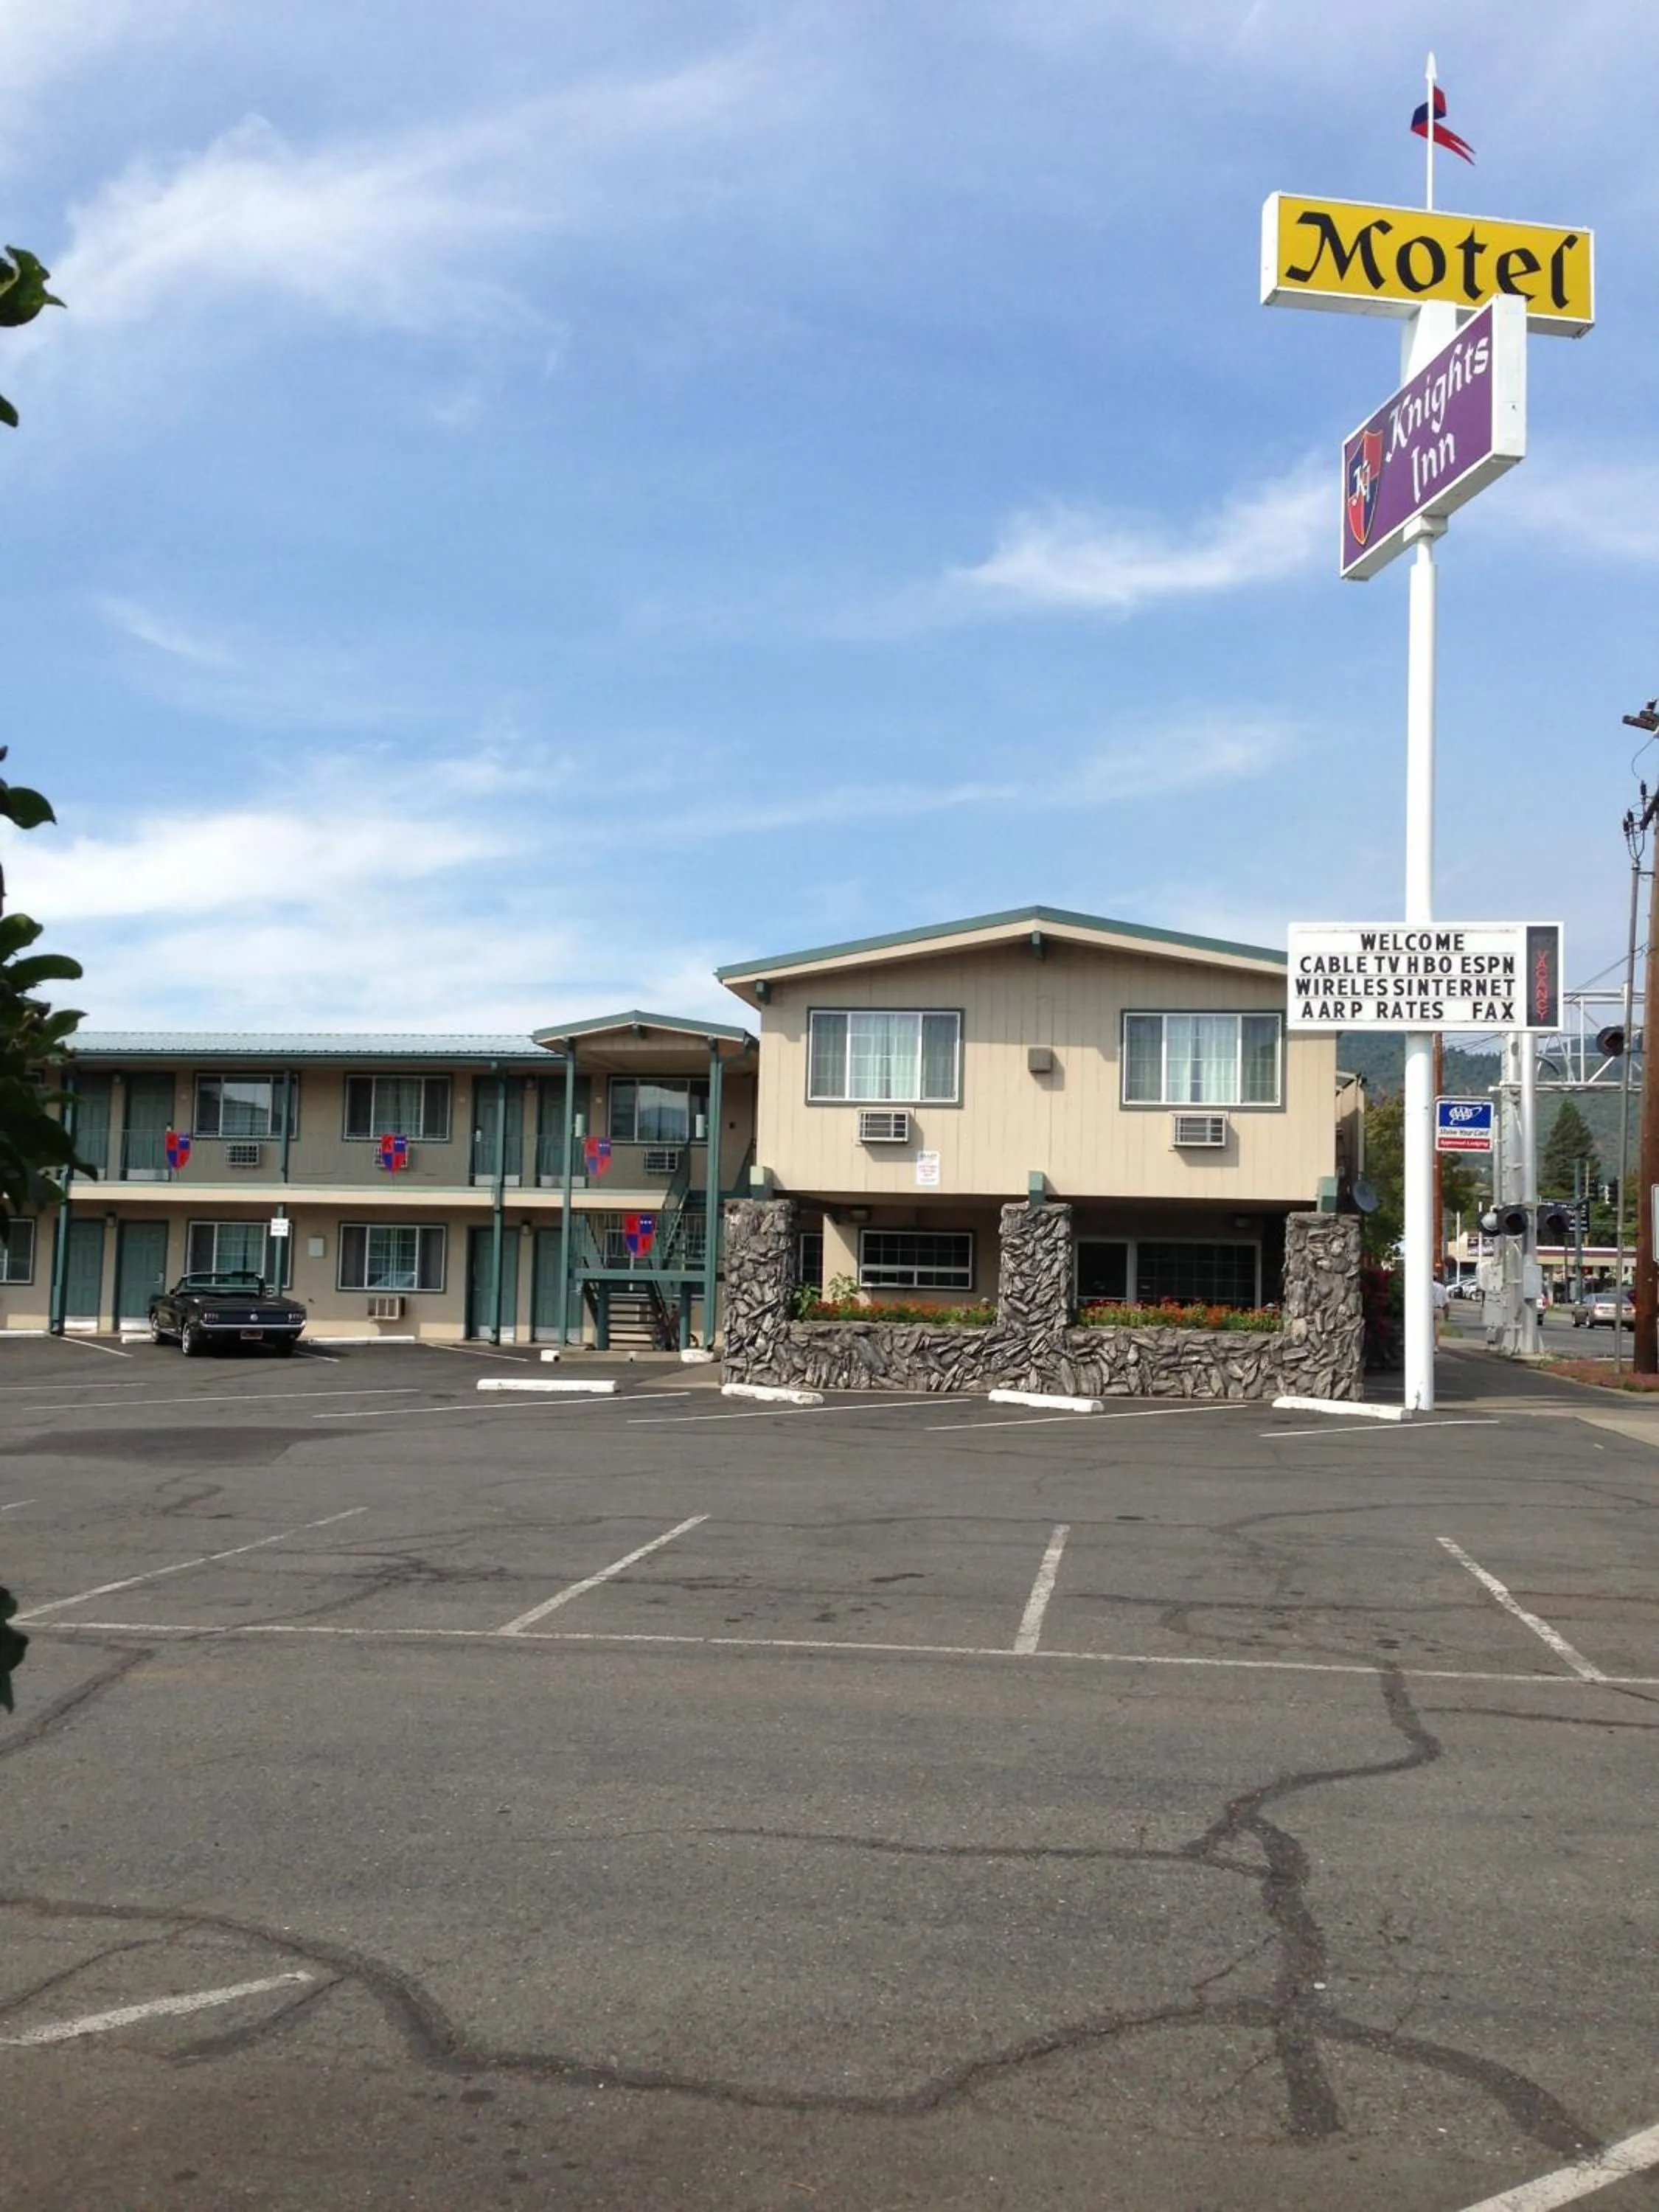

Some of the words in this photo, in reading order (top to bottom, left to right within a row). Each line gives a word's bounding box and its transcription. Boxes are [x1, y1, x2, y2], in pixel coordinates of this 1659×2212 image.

[1286, 211, 1578, 309] Motel
[1385, 336, 1489, 463] Knights
[1411, 433, 1455, 504] Inn
[1360, 933, 1465, 951] WELCOME
[1295, 978, 1405, 997] WIRELESS
[1408, 978, 1515, 997] INTERNET
[1300, 956, 1368, 974] CABLE
[1374, 956, 1399, 974] TV
[1407, 956, 1453, 974] HBO
[1461, 956, 1514, 974] ESPN
[1536, 949, 1549, 1021] VACANCY
[1301, 1001, 1363, 1019] AARP
[1376, 1001, 1444, 1019] RATES
[1472, 1002, 1514, 1019] FAX
